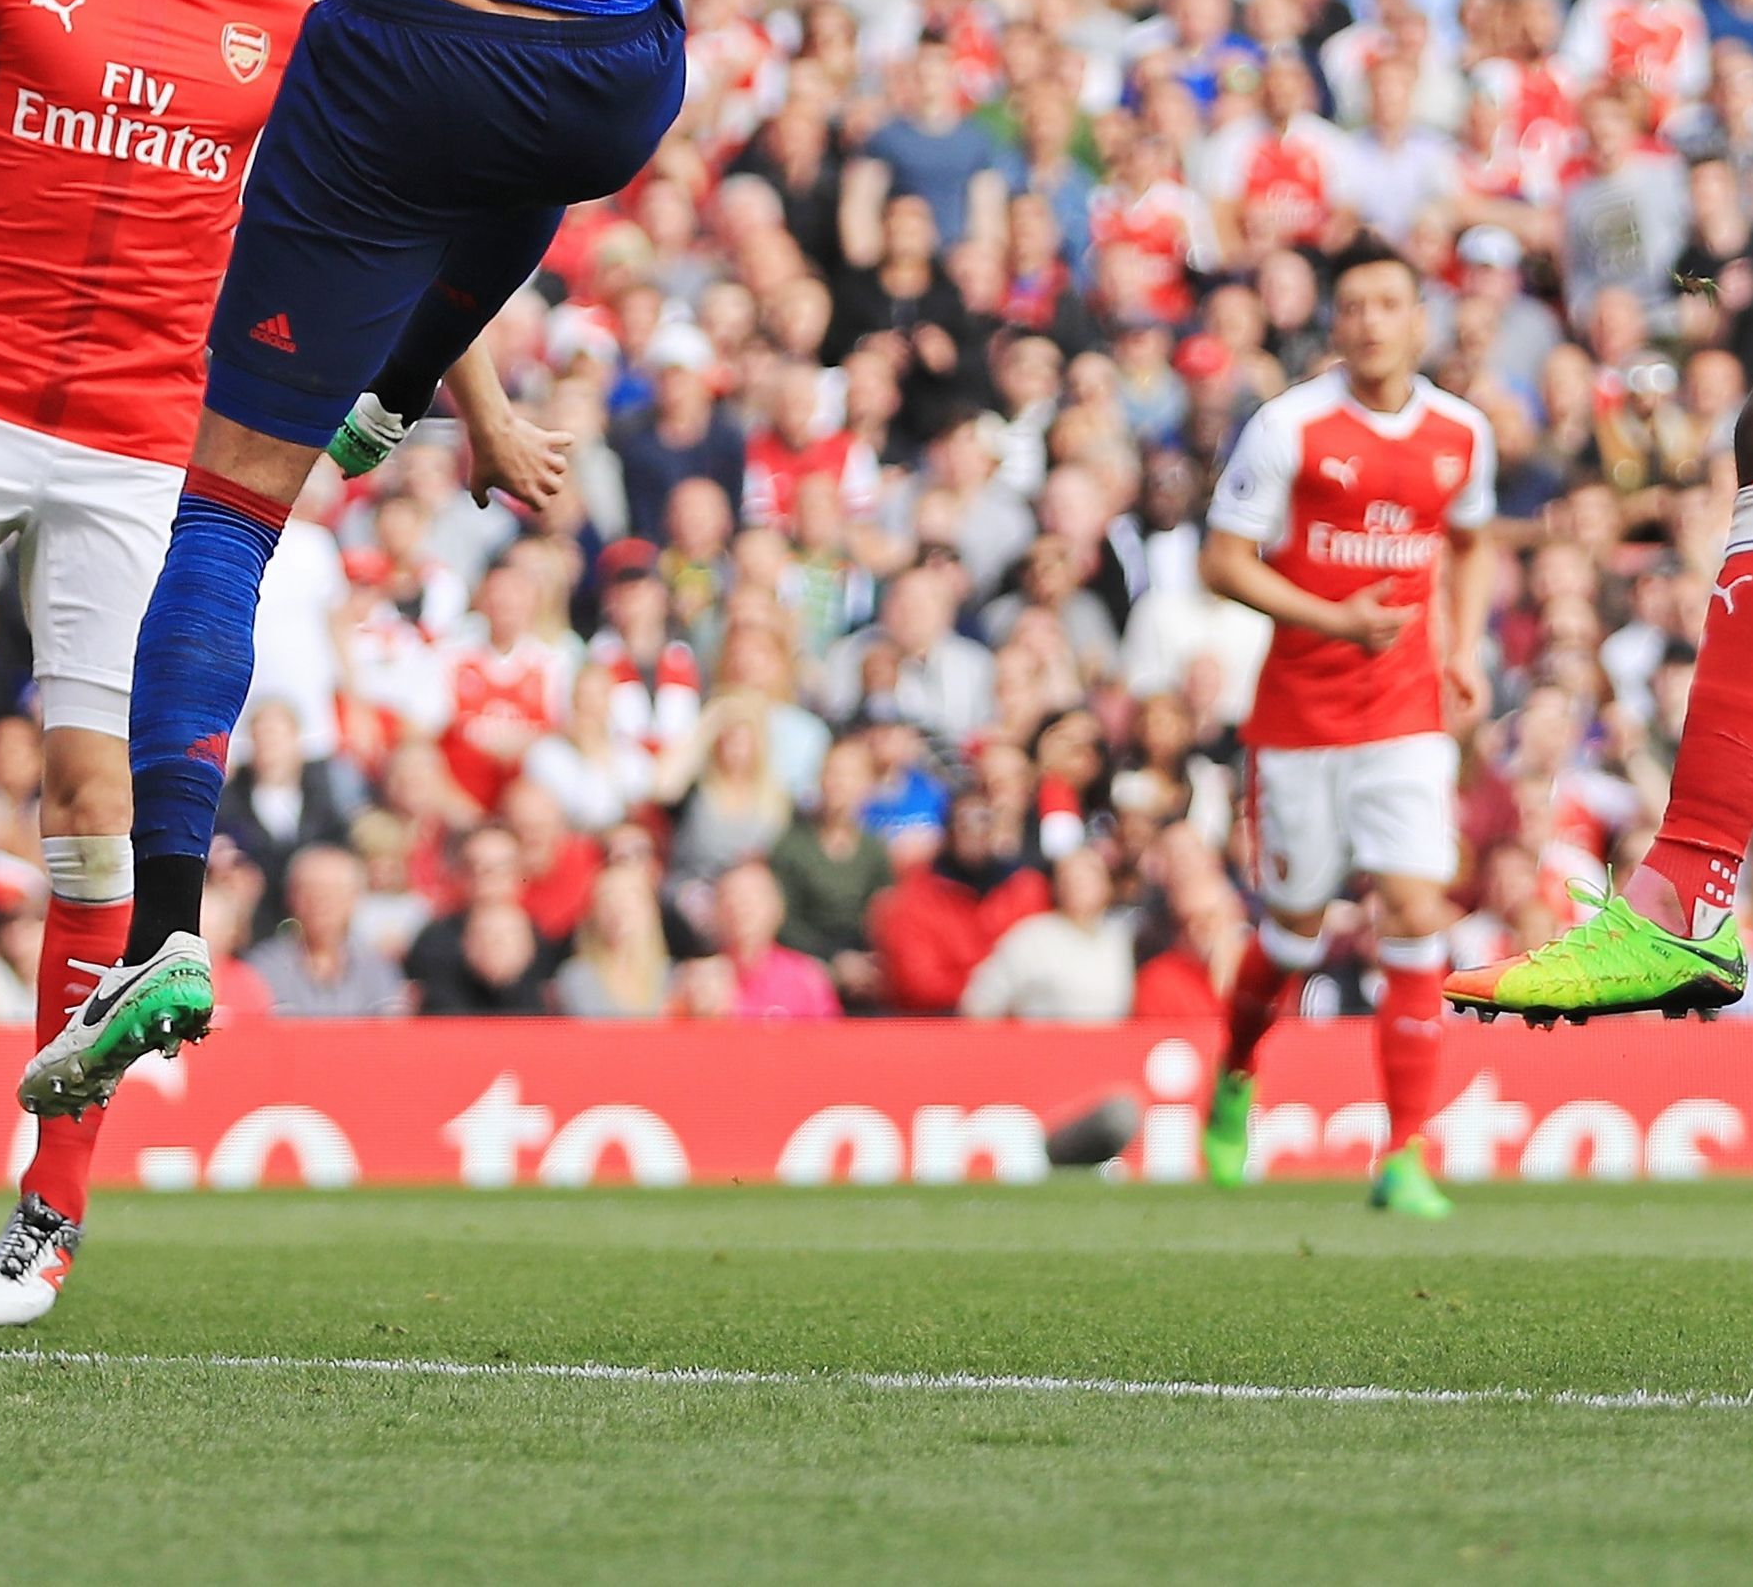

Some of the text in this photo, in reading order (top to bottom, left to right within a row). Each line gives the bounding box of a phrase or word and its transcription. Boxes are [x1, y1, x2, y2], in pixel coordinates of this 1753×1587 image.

[12, 87, 232, 183] Emirates
[101, 61, 176, 117] Fly
[443, 1069, 693, 1189] to
